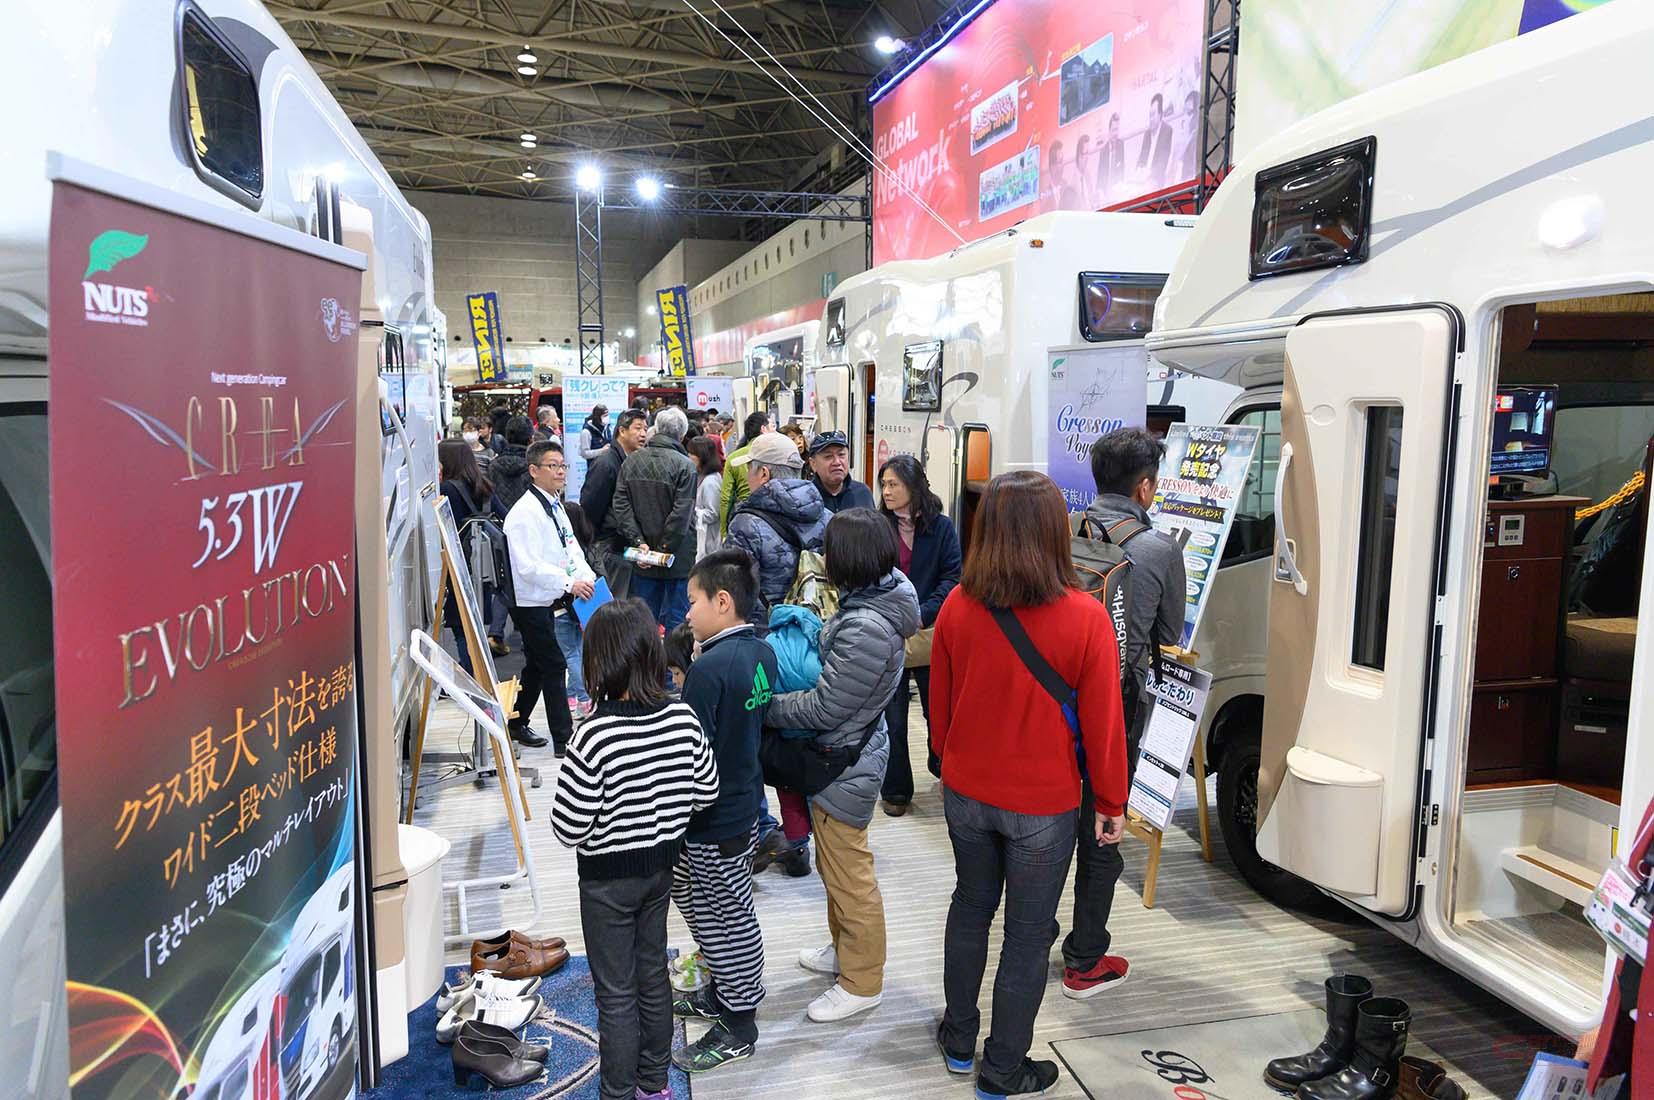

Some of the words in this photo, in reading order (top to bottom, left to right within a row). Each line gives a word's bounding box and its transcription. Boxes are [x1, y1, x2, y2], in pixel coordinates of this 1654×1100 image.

[877, 111, 919, 161] GLOBAL
[81, 281, 149, 317] NUTS
[1057, 405, 1122, 434] Cresson
[1180, 460, 1220, 480] 発売記念
[1186, 441, 1227, 461] Wタイヤ
[192, 481, 303, 575] 5.3W
[118, 554, 349, 710] EVOLUTION
[164, 725, 338, 889] ワイド二段ベッド仕様
